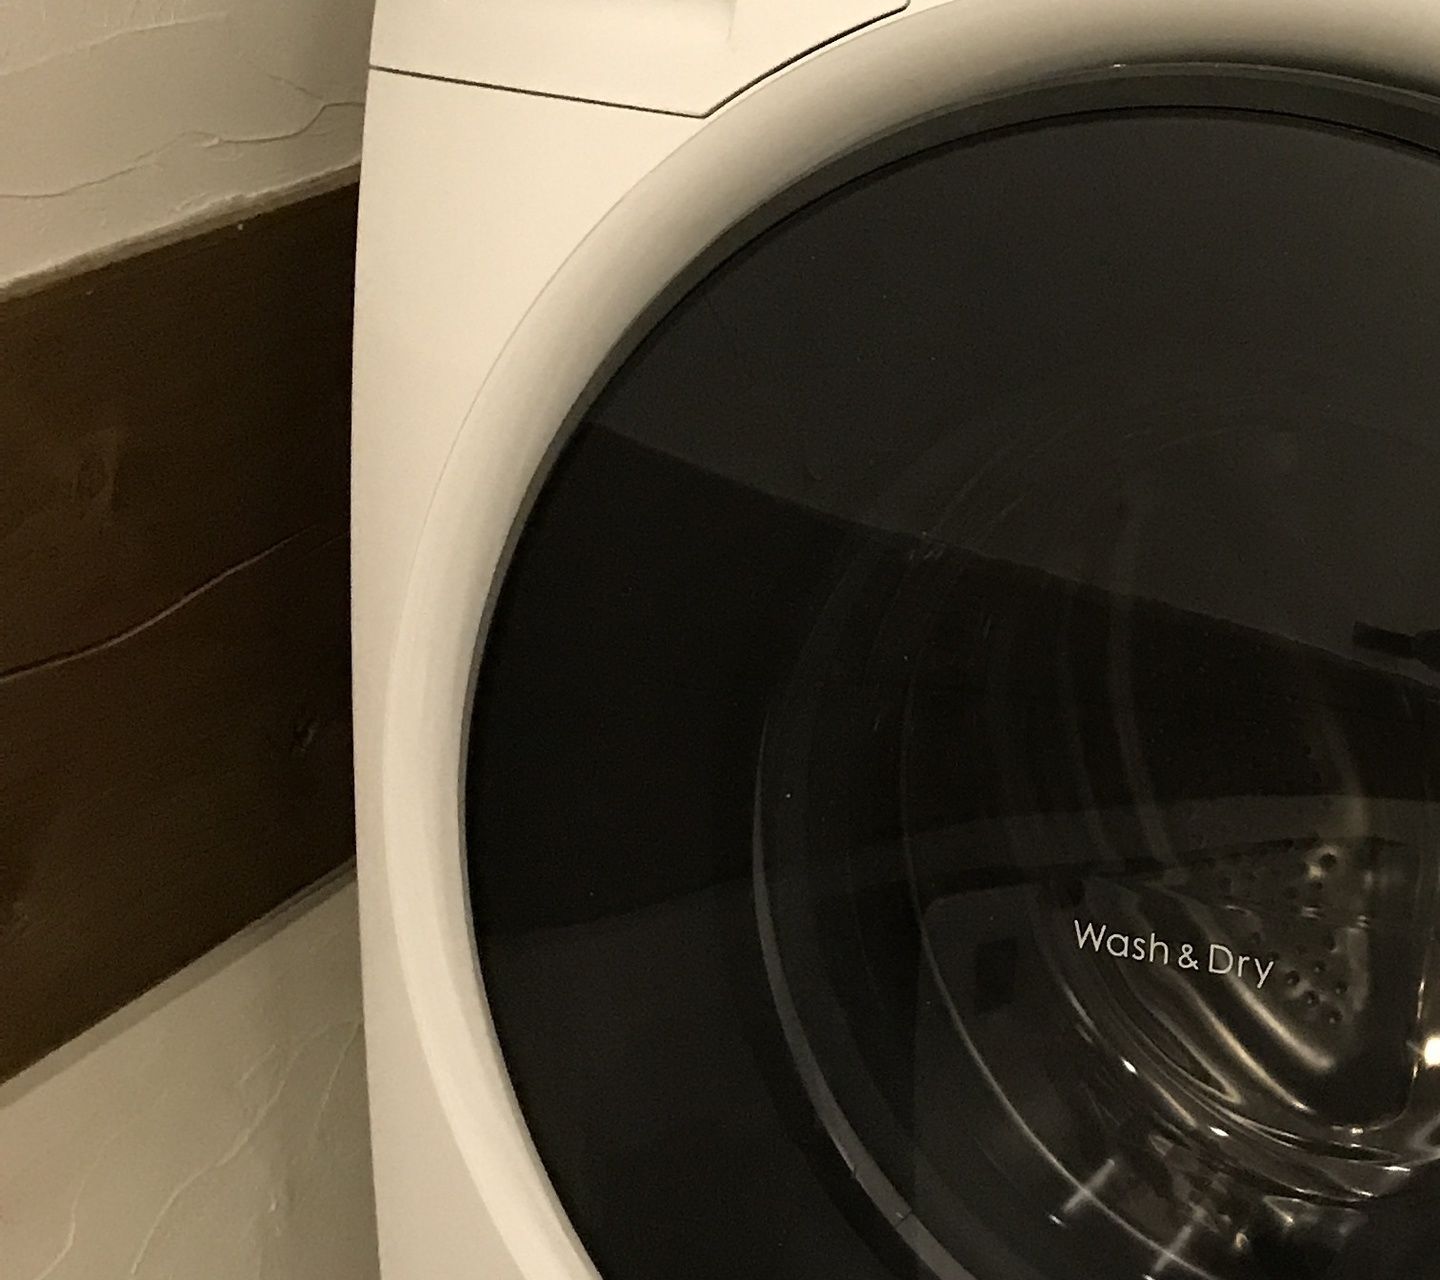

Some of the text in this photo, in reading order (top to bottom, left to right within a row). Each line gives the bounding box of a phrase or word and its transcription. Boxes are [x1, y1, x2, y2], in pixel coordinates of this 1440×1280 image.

[1074, 919, 1275, 989] Wash & Dry
